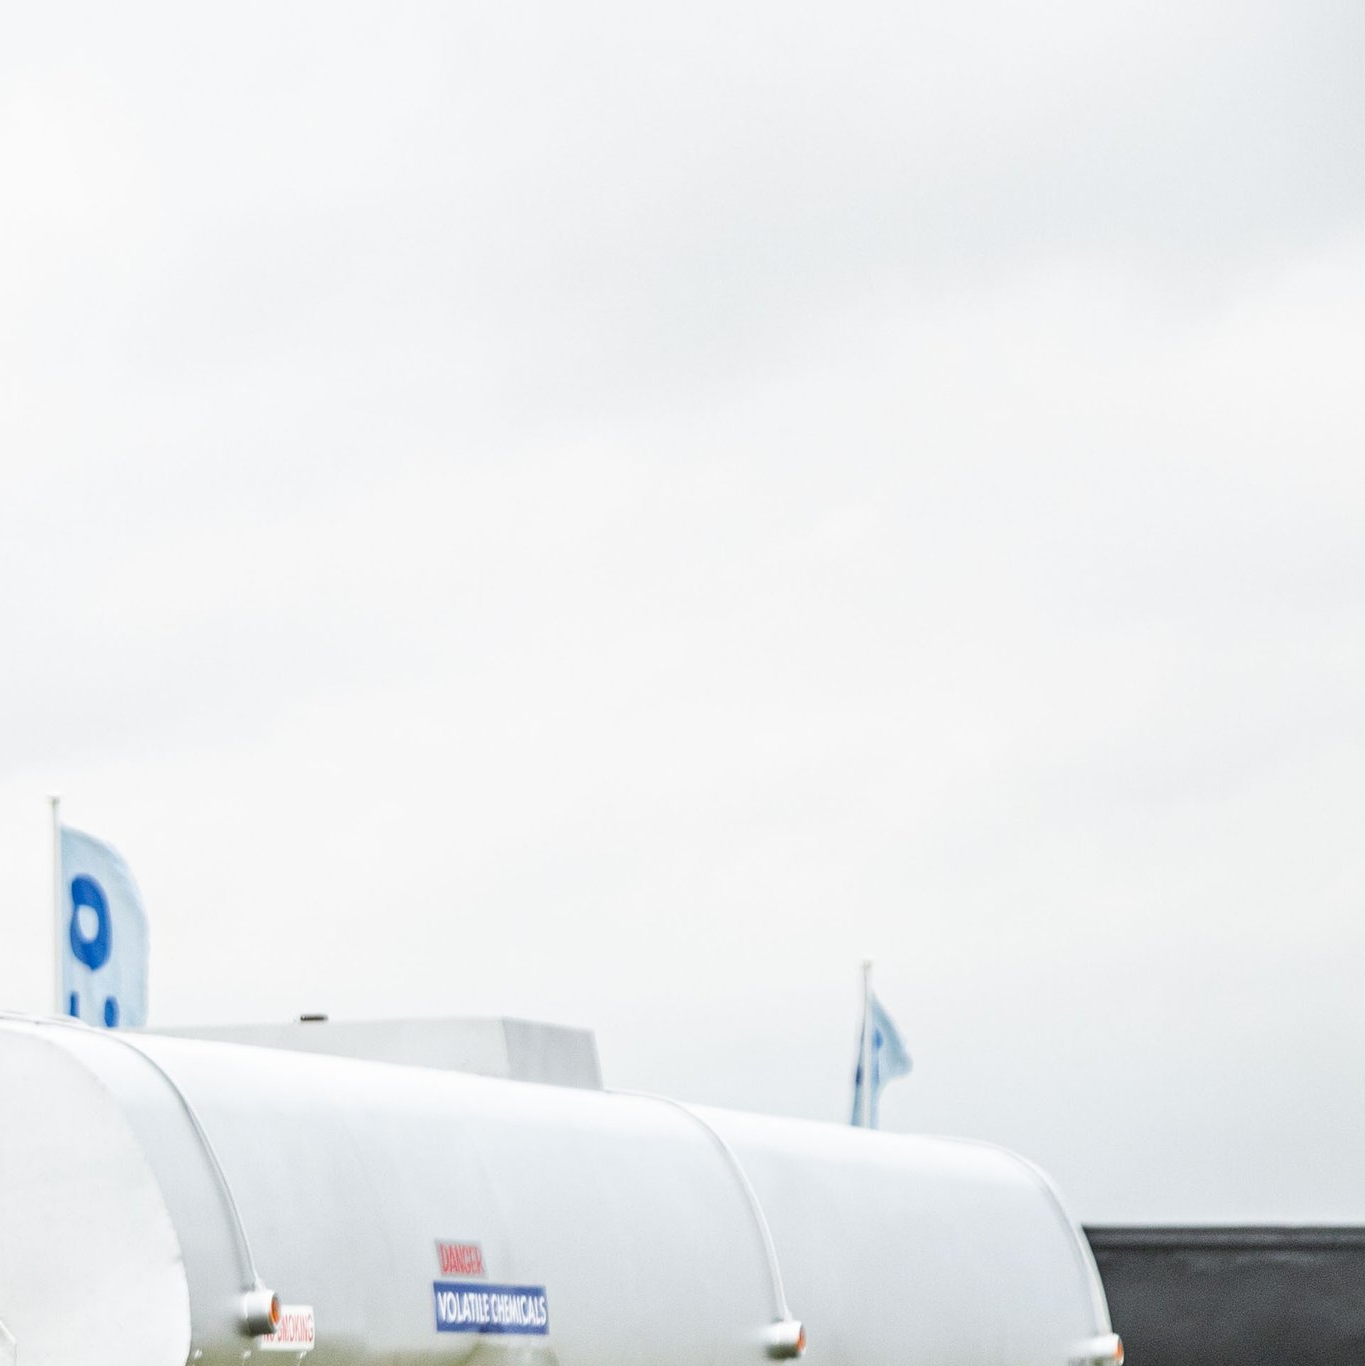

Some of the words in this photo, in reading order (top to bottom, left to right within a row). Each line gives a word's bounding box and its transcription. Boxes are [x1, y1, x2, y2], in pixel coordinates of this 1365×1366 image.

[437, 1244, 483, 1274] DANGER
[438, 1291, 490, 1323] VOLATILE
[491, 1293, 547, 1326] CHEMICALS
